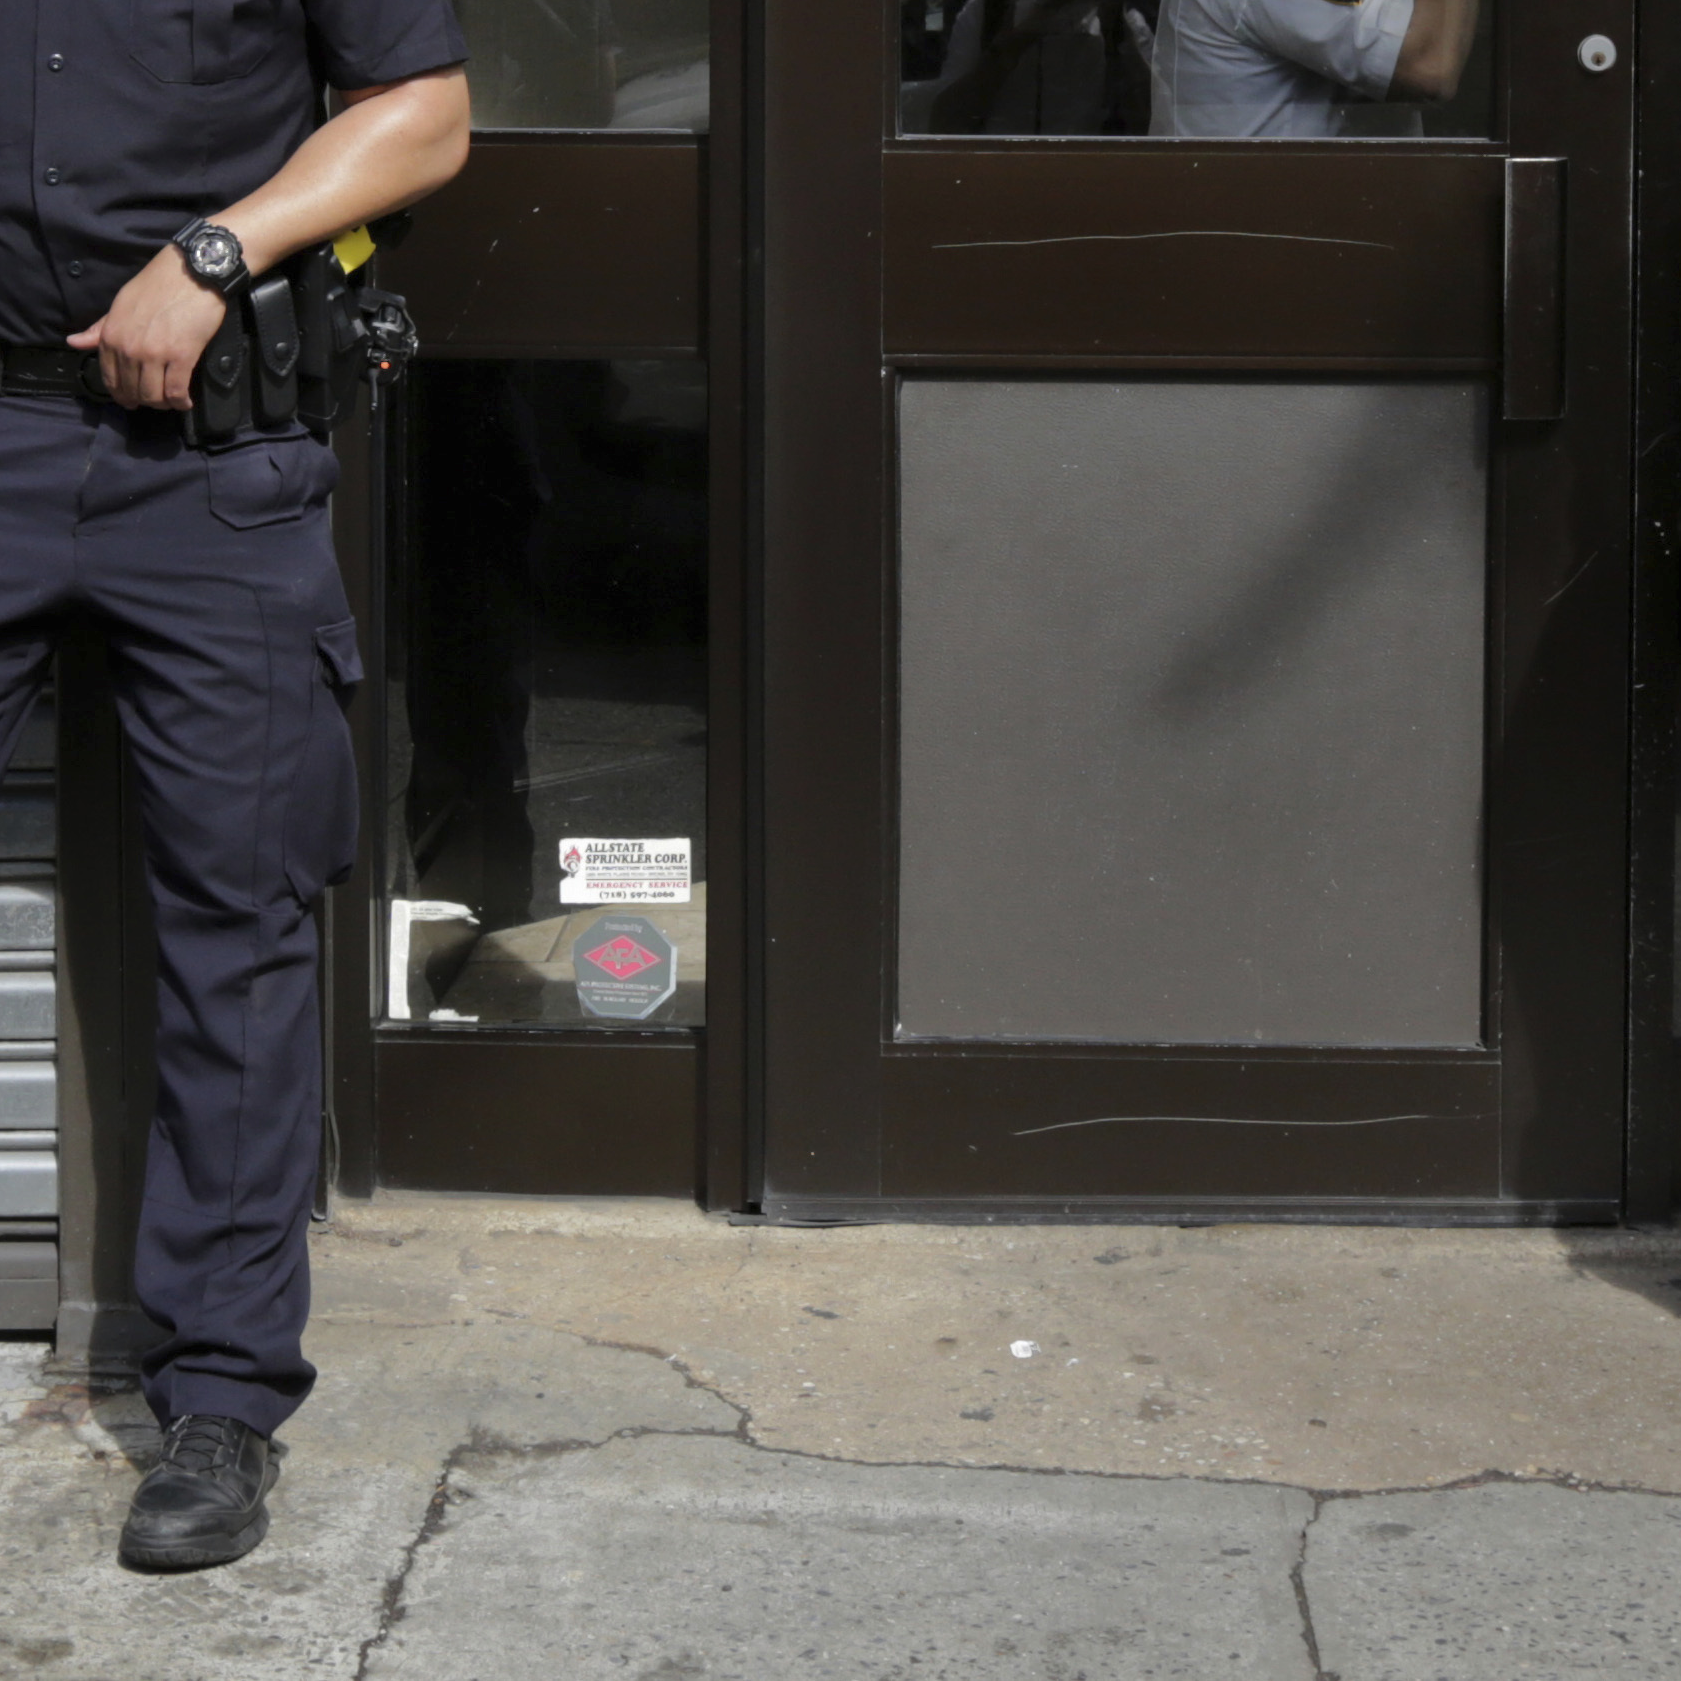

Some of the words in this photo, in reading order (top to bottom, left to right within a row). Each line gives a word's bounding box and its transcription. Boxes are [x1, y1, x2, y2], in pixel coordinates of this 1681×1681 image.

[585, 842, 645, 853] ALLSTATE
[585, 854, 652, 864] SPRINKLER
[655, 854, 688, 864] CORP.
[599, 890, 627, 901] (718)
[598, 945, 647, 970] AFA
